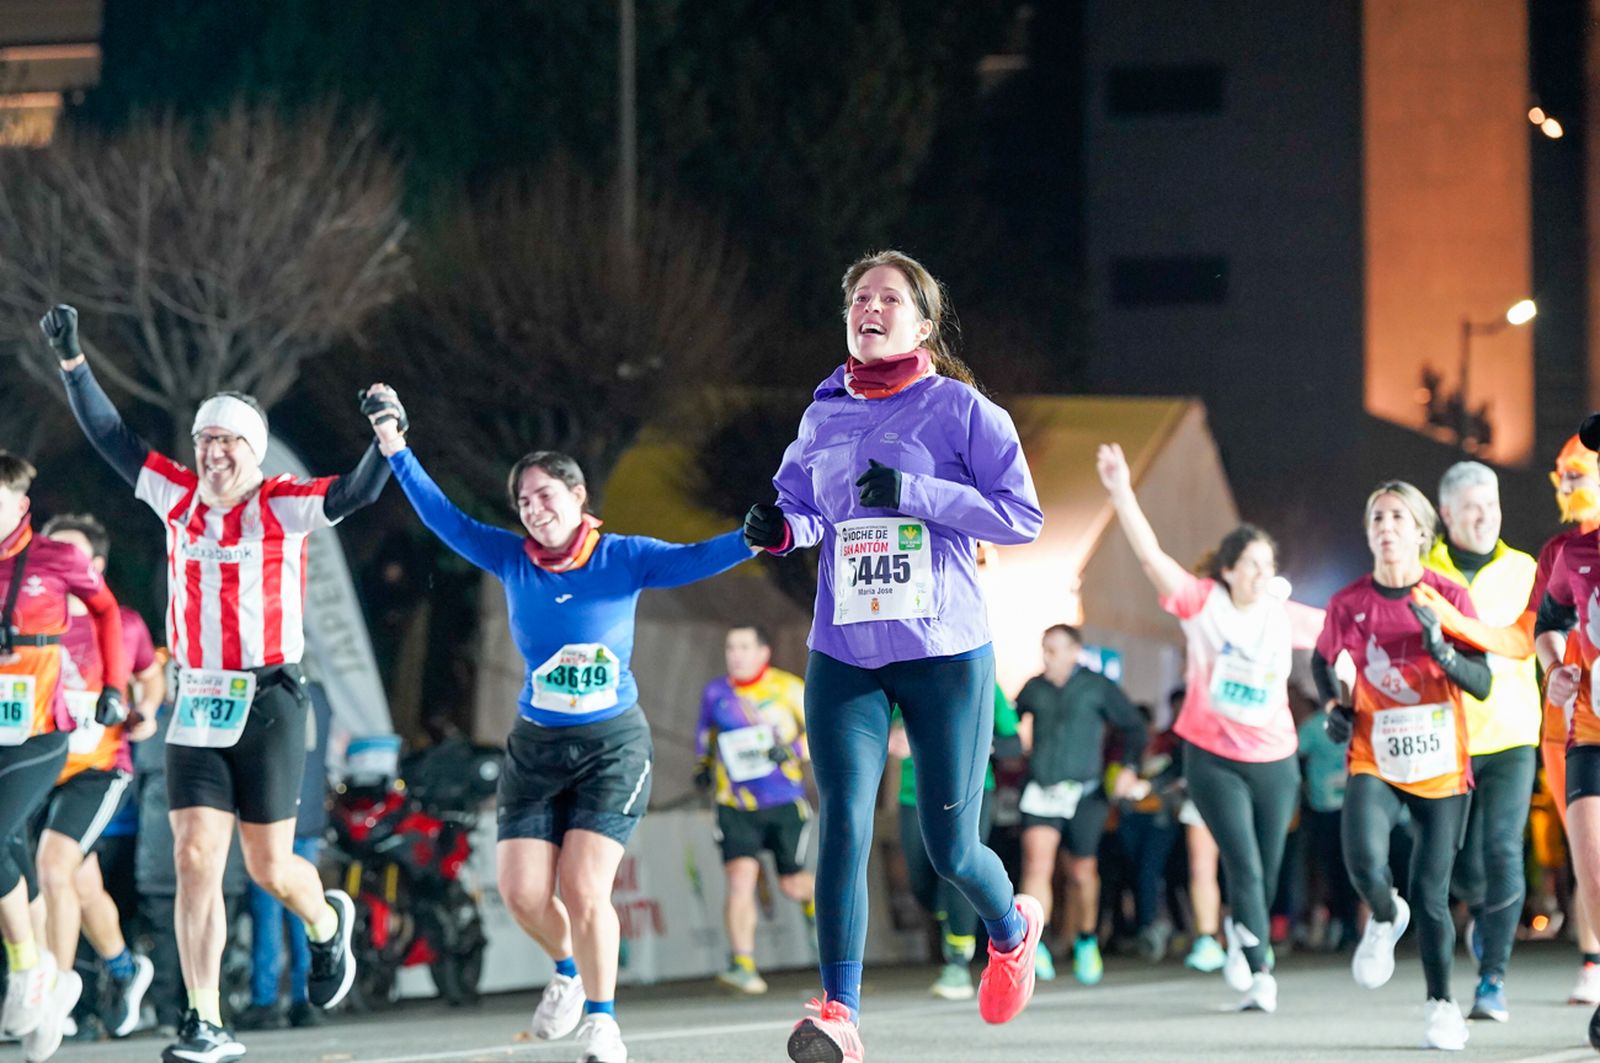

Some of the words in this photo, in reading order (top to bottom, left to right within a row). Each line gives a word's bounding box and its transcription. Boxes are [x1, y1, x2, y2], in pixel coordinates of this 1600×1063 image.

[875, 530, 888, 540] DE
[854, 540, 888, 555] ANTÓN
[848, 554, 911, 587] 5445
[1387, 733, 1440, 757] 3855
